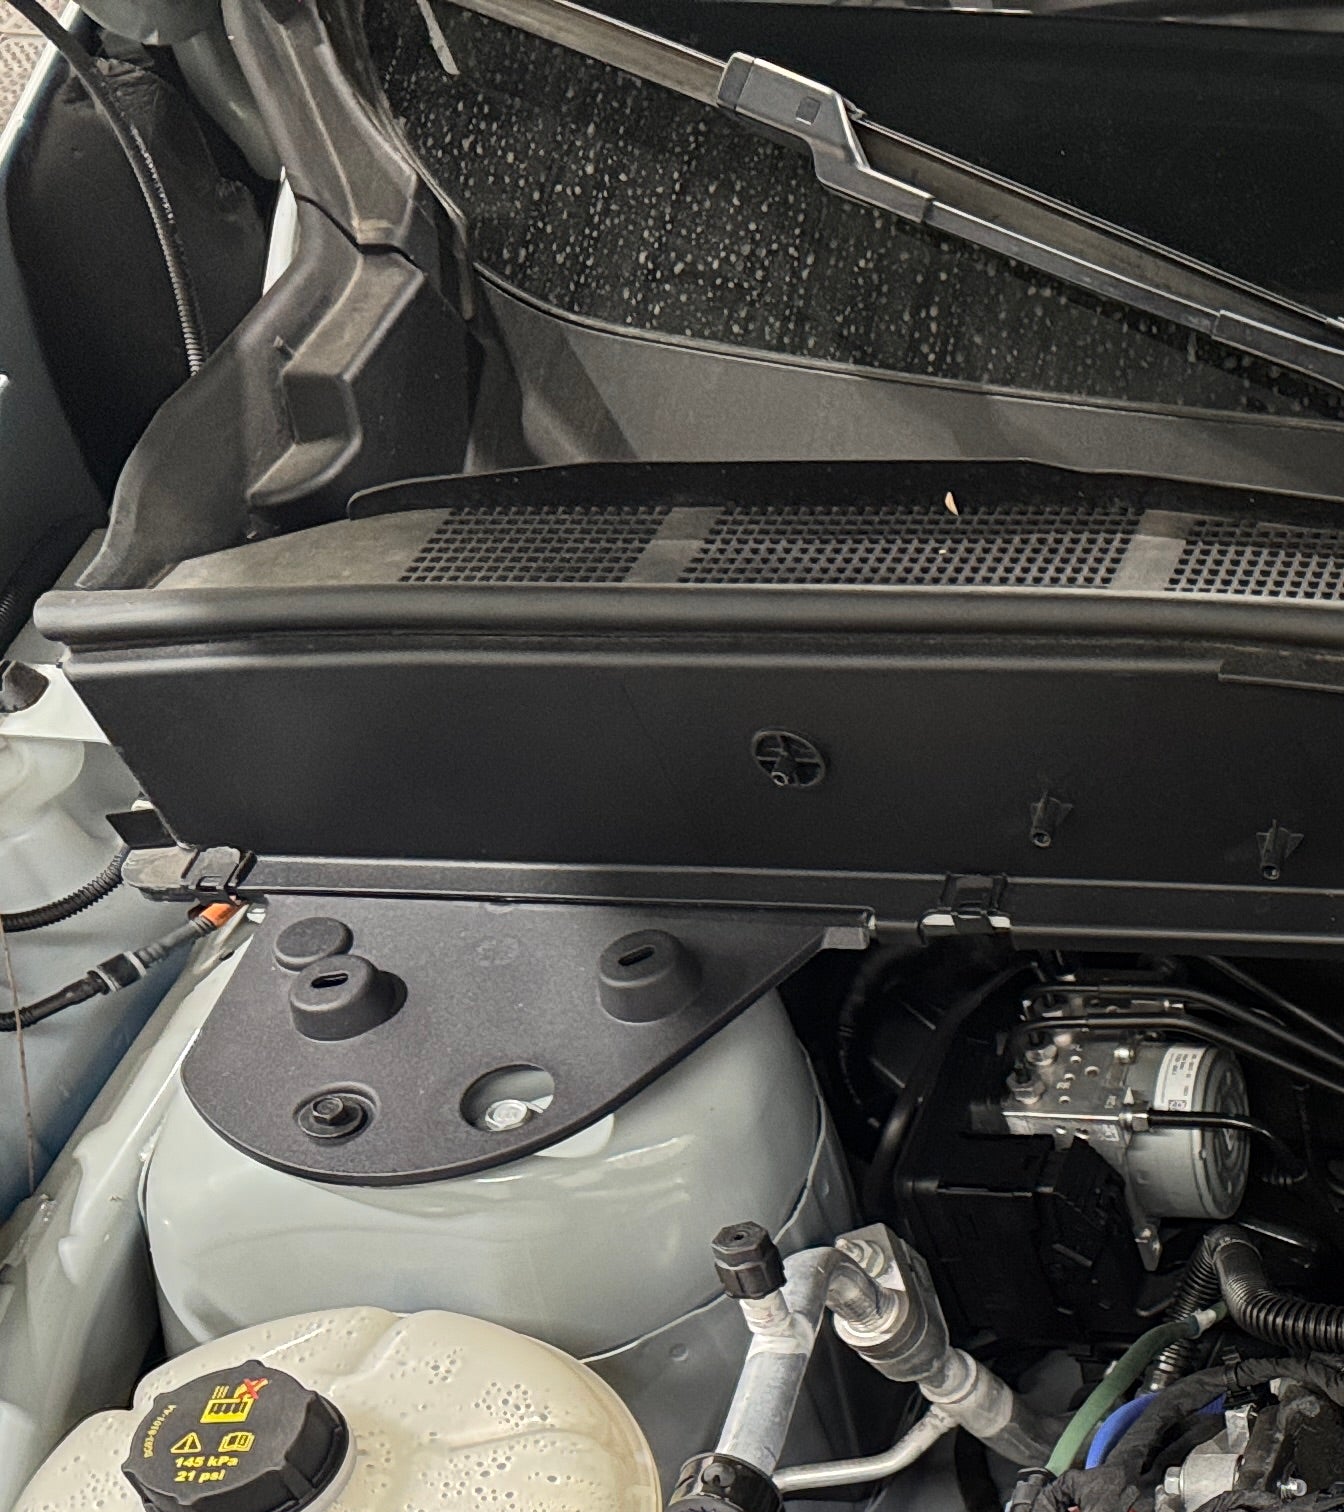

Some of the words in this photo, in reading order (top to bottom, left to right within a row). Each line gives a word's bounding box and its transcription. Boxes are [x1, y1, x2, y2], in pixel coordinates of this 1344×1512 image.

[175, 1456, 204, 1468] 145
[207, 1455, 239, 1468] kPa
[174, 1470, 196, 1482] 21
[199, 1469, 226, 1484] psi
